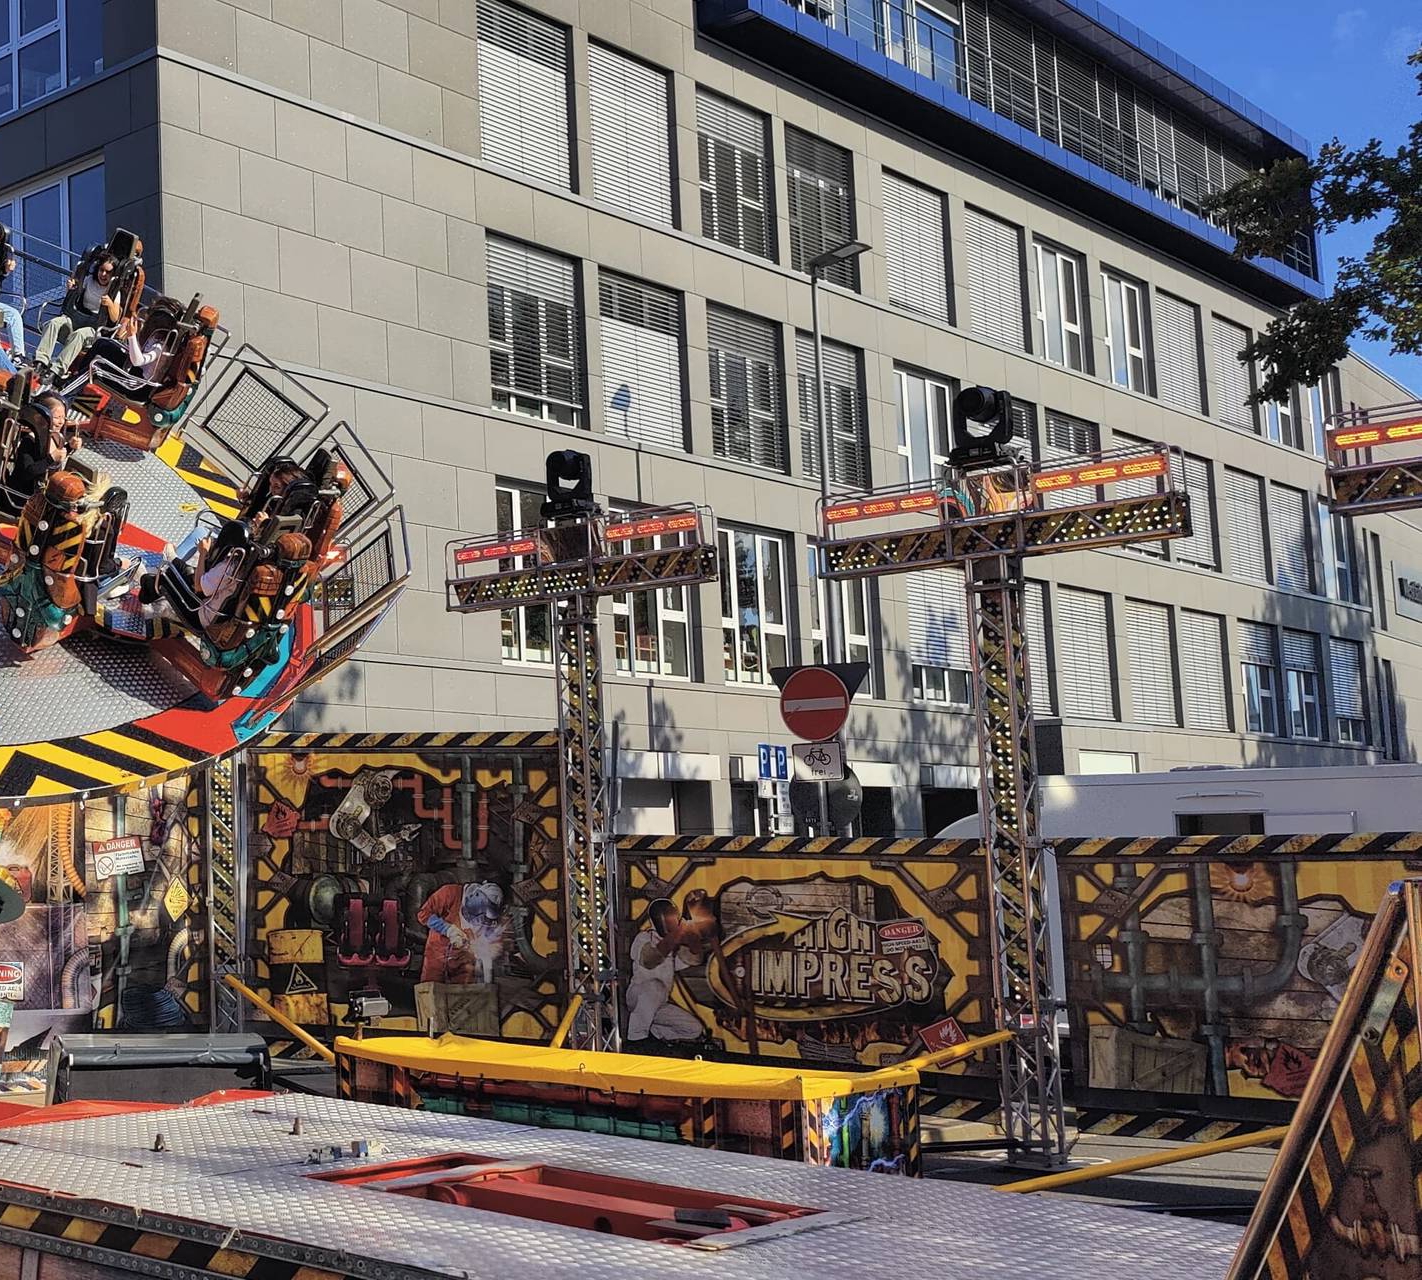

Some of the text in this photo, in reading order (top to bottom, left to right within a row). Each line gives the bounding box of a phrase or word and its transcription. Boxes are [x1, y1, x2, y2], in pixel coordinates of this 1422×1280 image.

[760, 747, 768, 774] P
[777, 750, 785, 773] P
[811, 768, 827, 776] frei
[106, 840, 136, 851] DANGER
[794, 911, 873, 952] HIGH
[884, 925, 919, 936] DANGER
[751, 951, 931, 1003] IMPRESS
